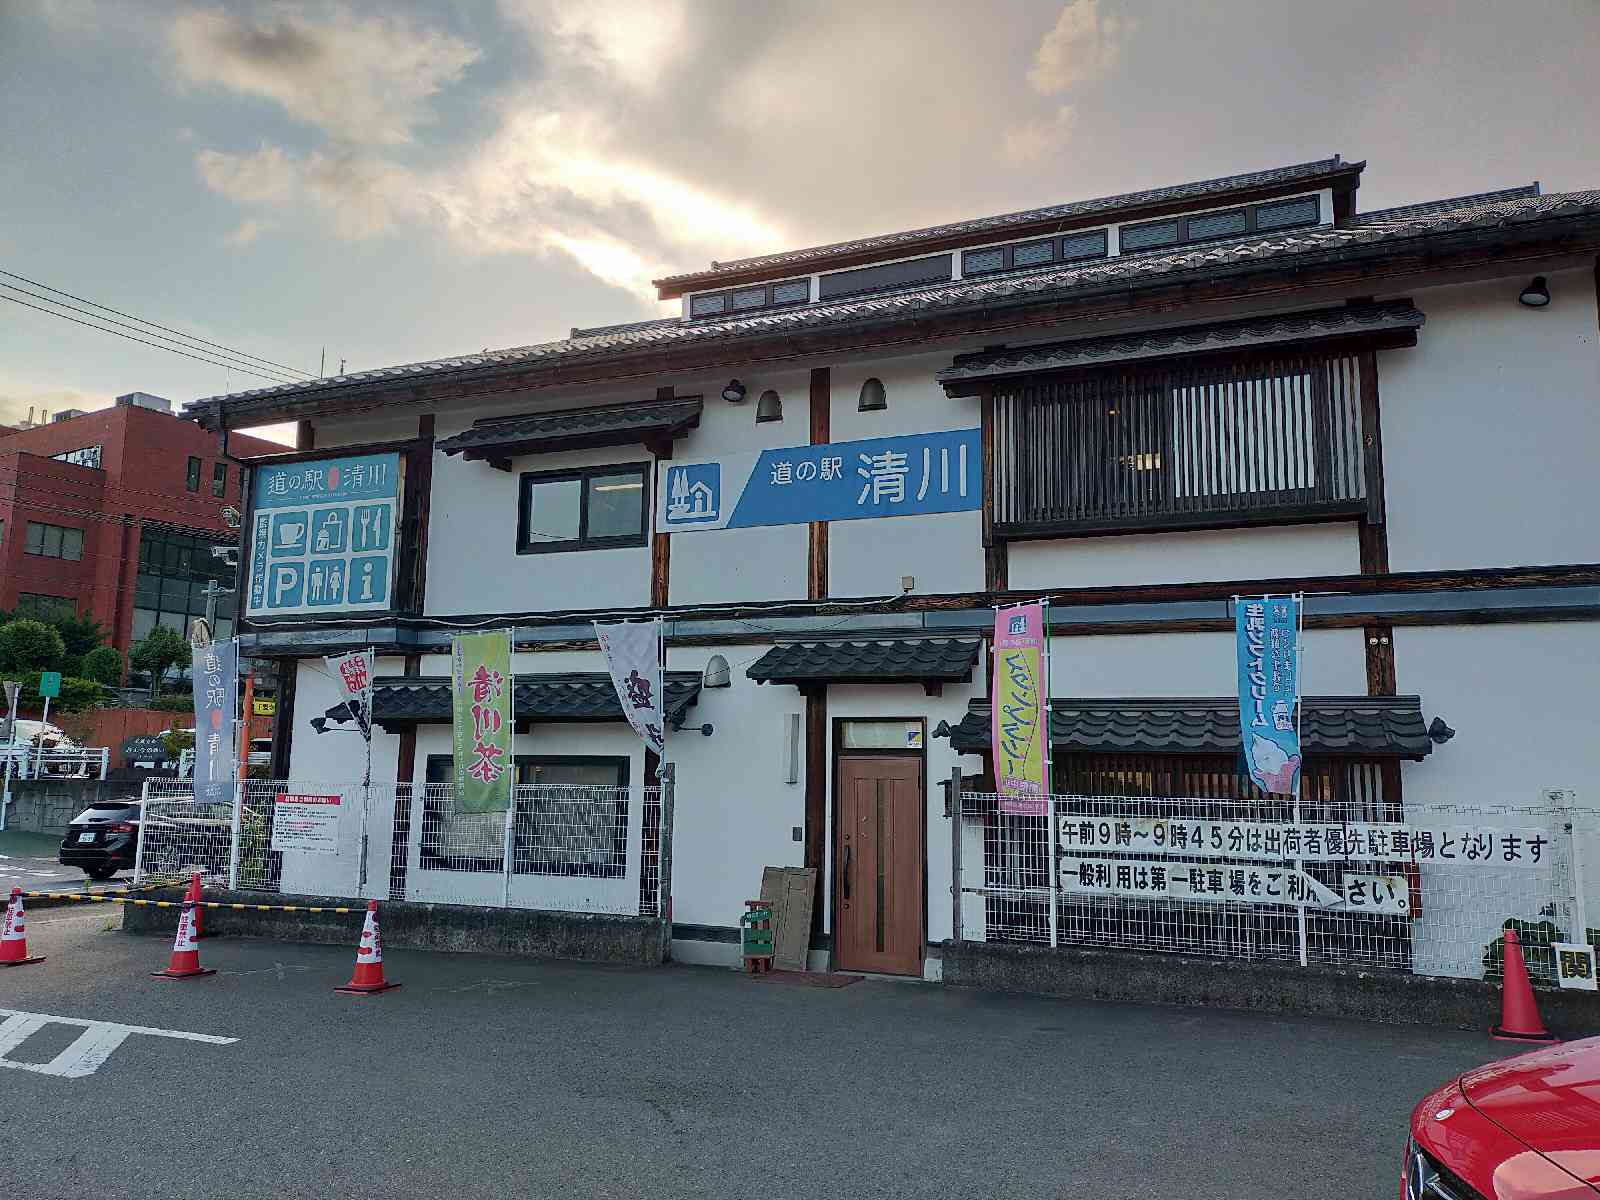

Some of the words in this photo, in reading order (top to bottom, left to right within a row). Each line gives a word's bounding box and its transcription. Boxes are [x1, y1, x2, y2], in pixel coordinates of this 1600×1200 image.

[267, 469, 325, 496] 道の駅
[343, 463, 387, 490] 清川
[769, 455, 843, 486] 道の駅
[857, 444, 968, 506] 清川
[275, 567, 298, 605] P
